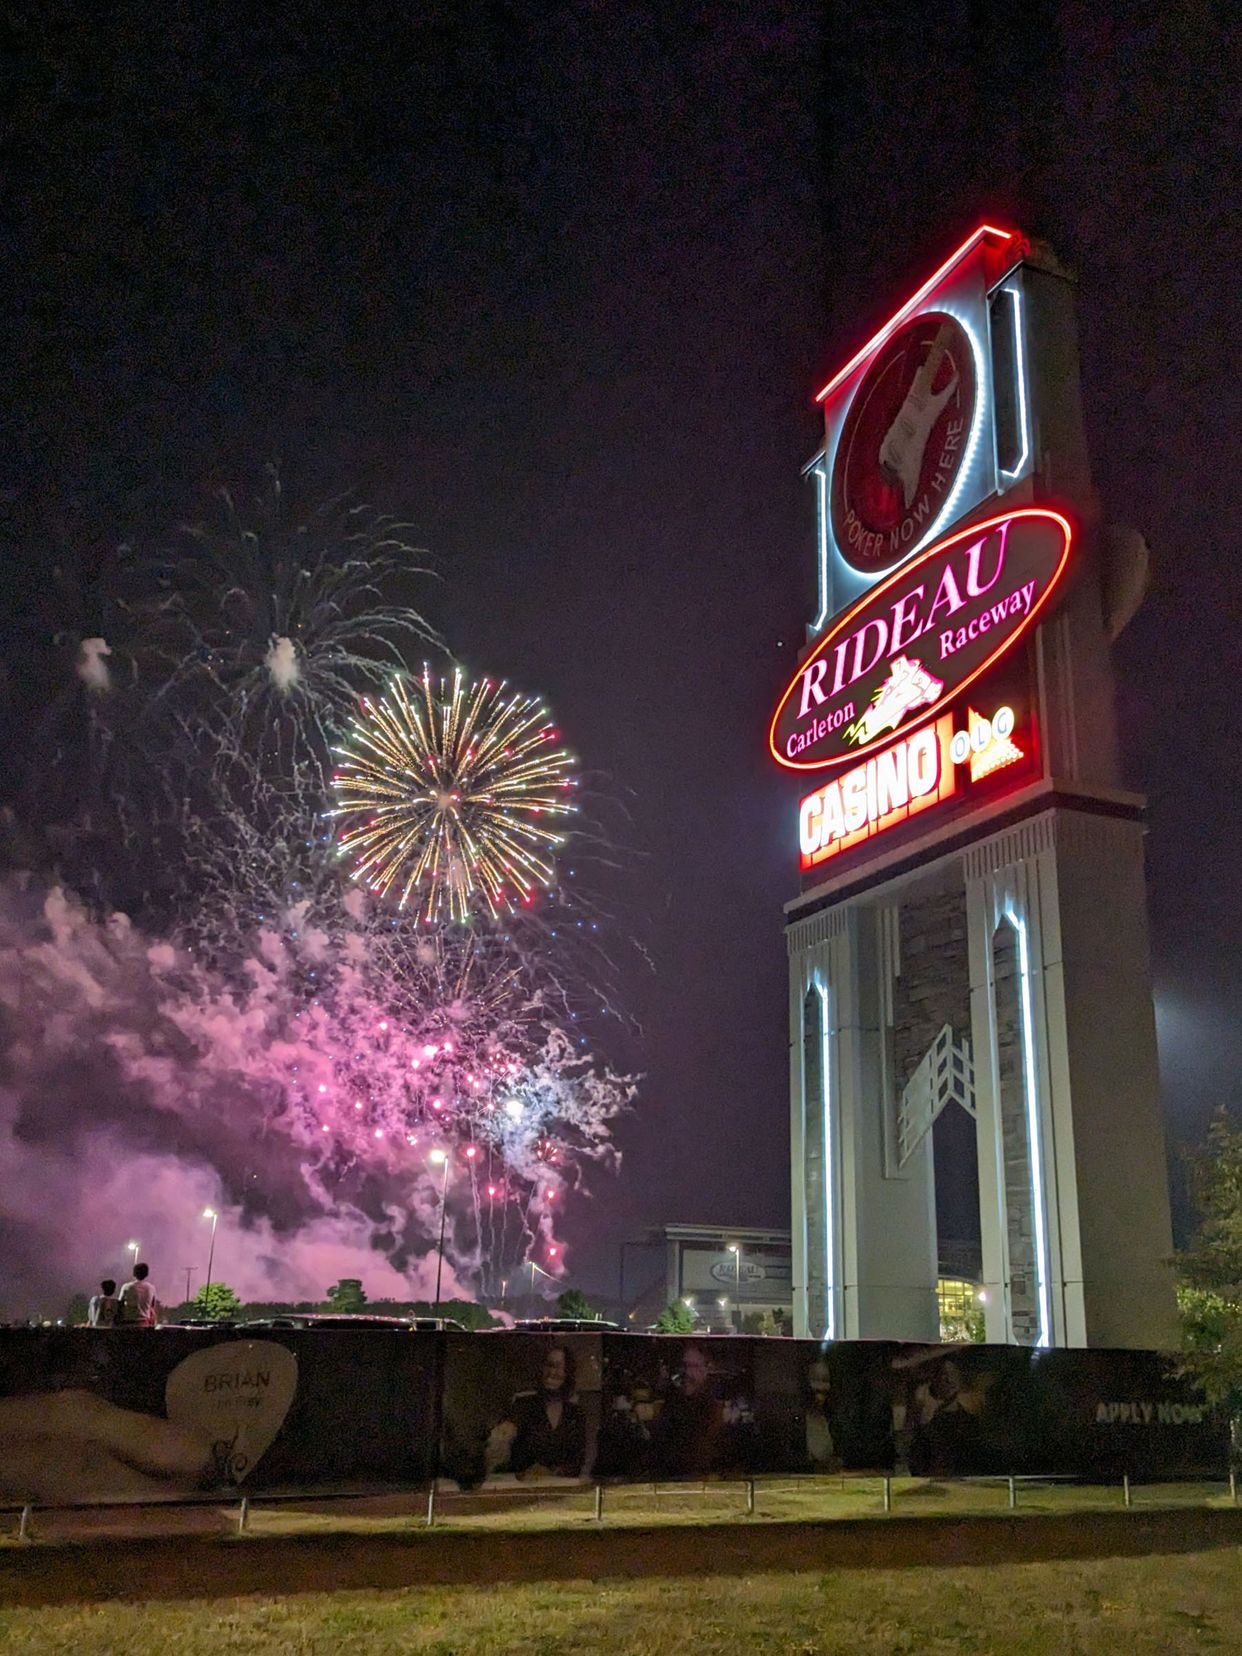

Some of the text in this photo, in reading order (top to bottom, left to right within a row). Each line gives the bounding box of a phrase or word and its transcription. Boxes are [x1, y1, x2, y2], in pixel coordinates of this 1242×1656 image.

[843, 417, 965, 557] POKER NOW HERE
[787, 580, 1036, 757] Carleton Raceway
[796, 519, 1012, 719] RIDEAU
[800, 728, 941, 855] CASINO
[204, 1371, 270, 1393] BRIAN
[1096, 1401, 1153, 1424] APPLY
